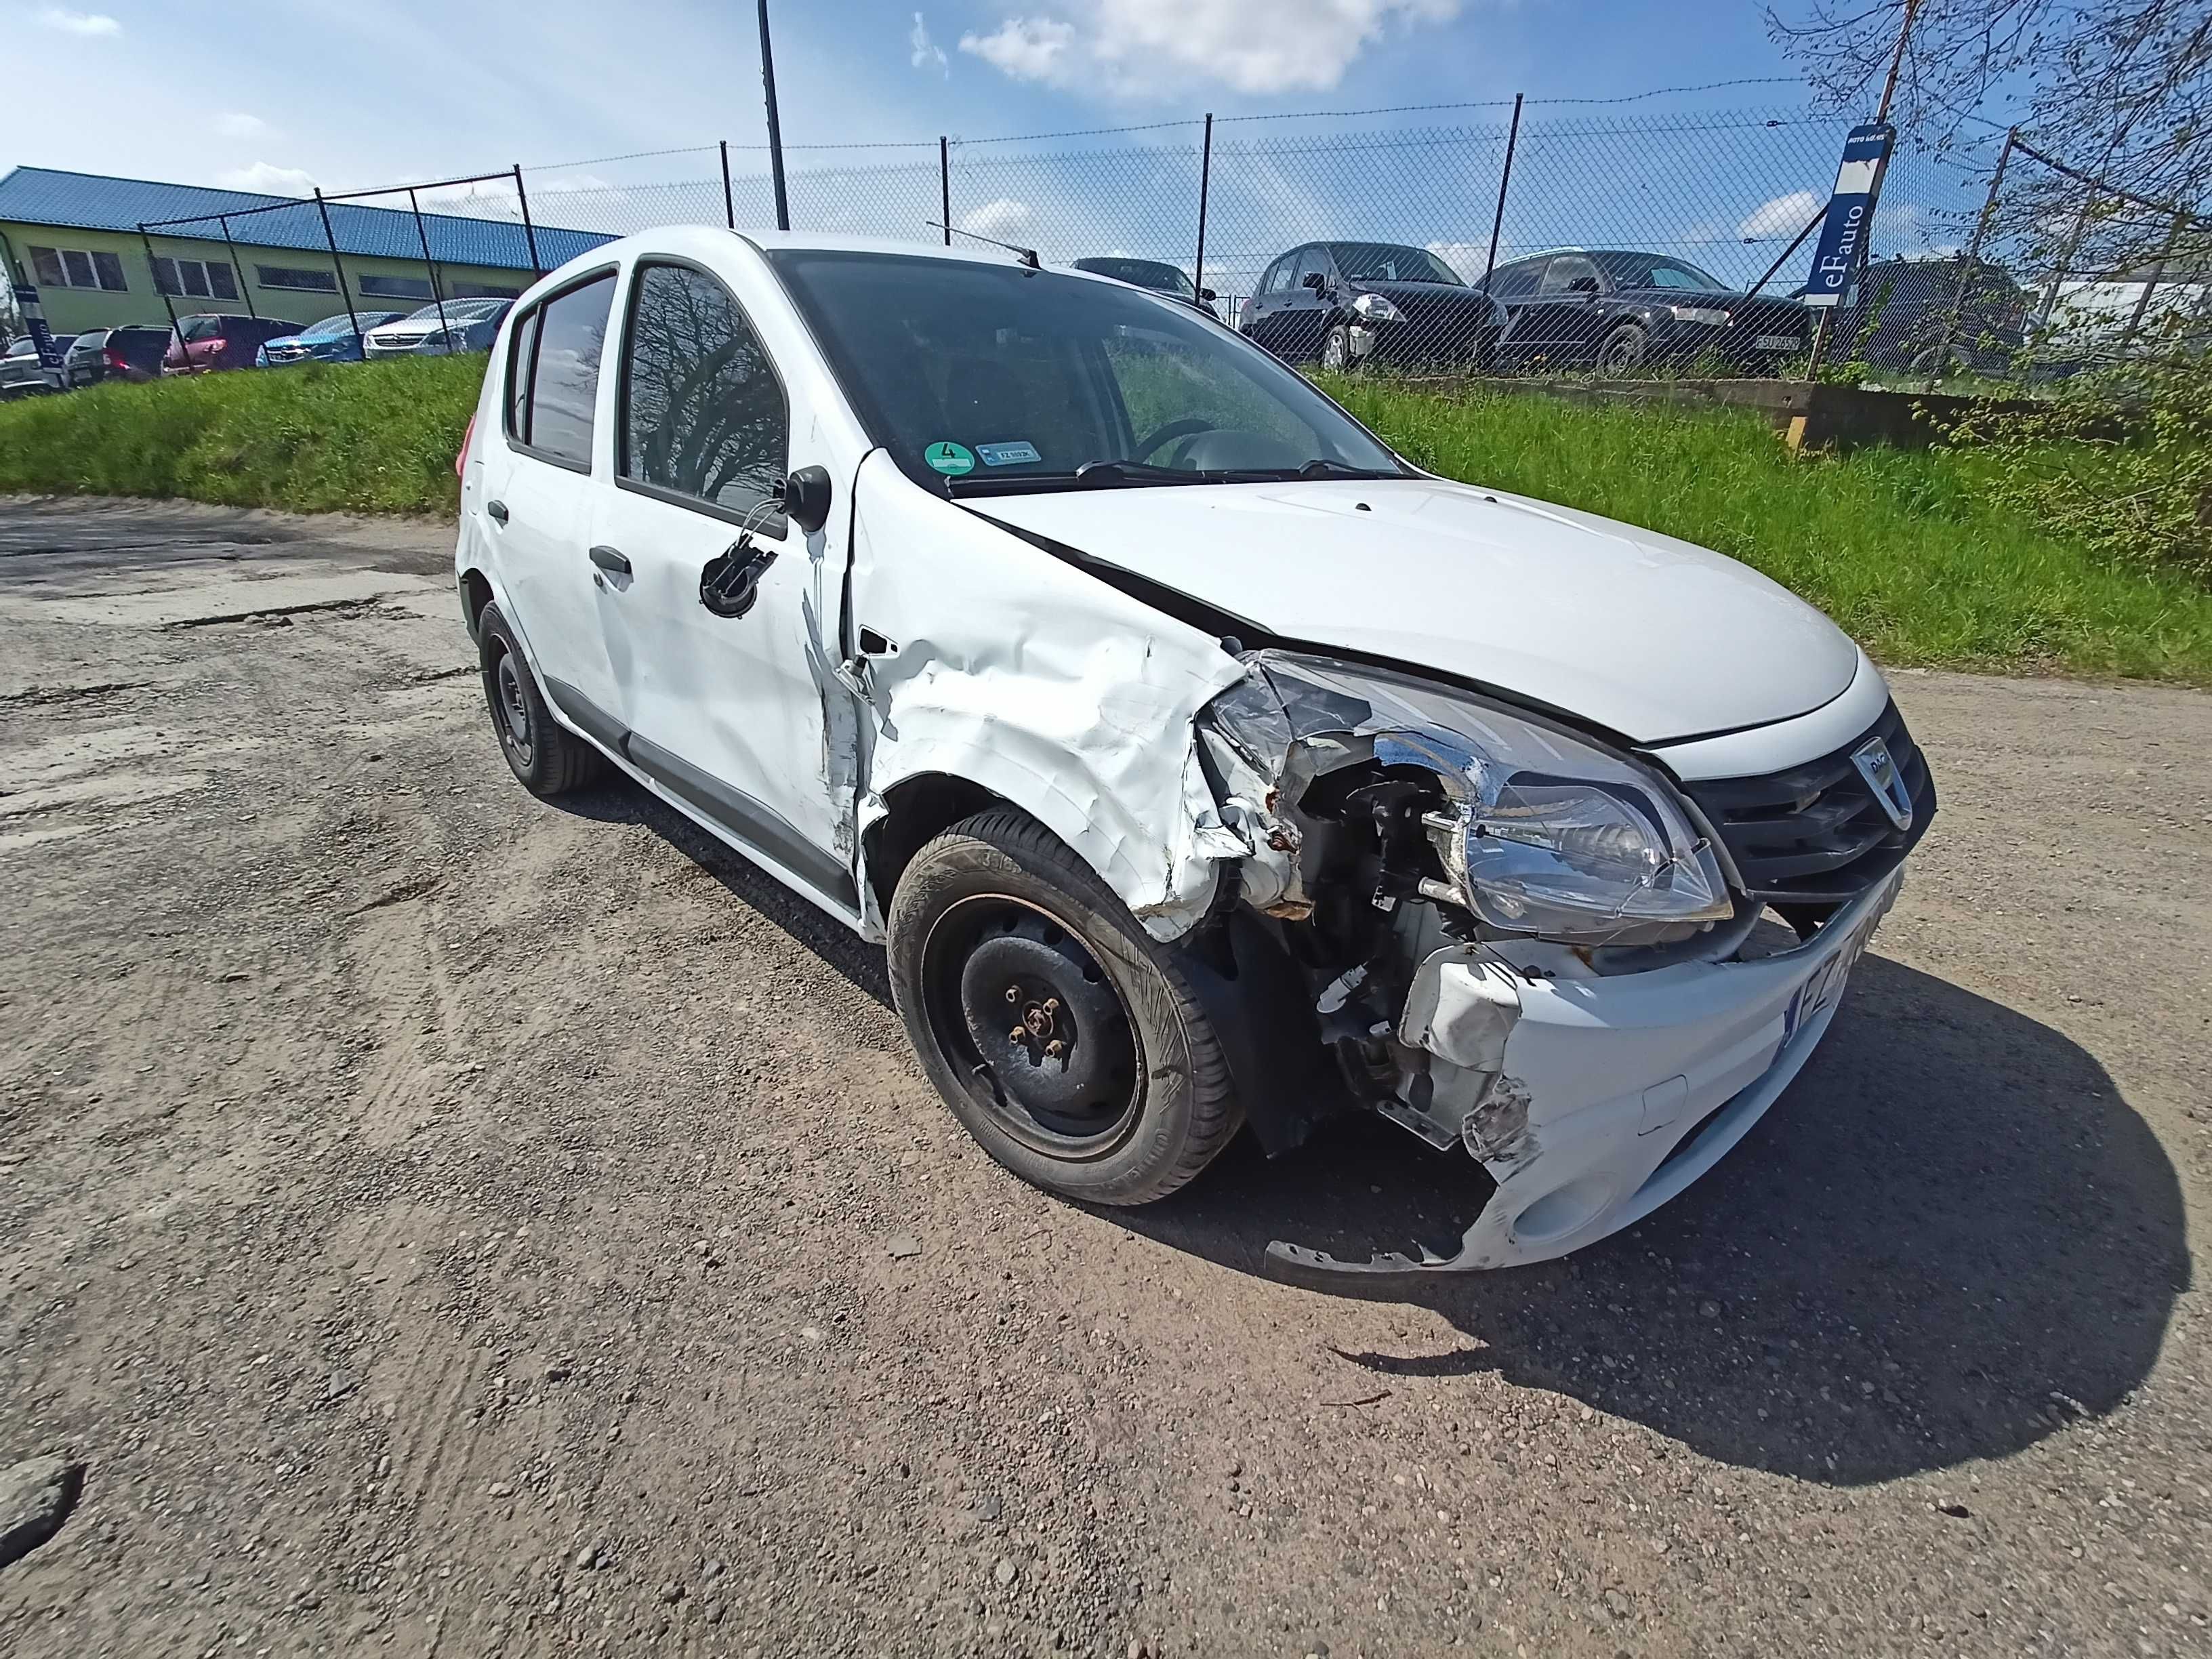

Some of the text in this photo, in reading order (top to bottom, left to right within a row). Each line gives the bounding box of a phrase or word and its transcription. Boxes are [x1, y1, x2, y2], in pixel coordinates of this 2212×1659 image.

[1820, 205, 1864, 288] eFauto
[1757, 337, 1774, 348] FSU
[942, 443, 956, 459] 4
